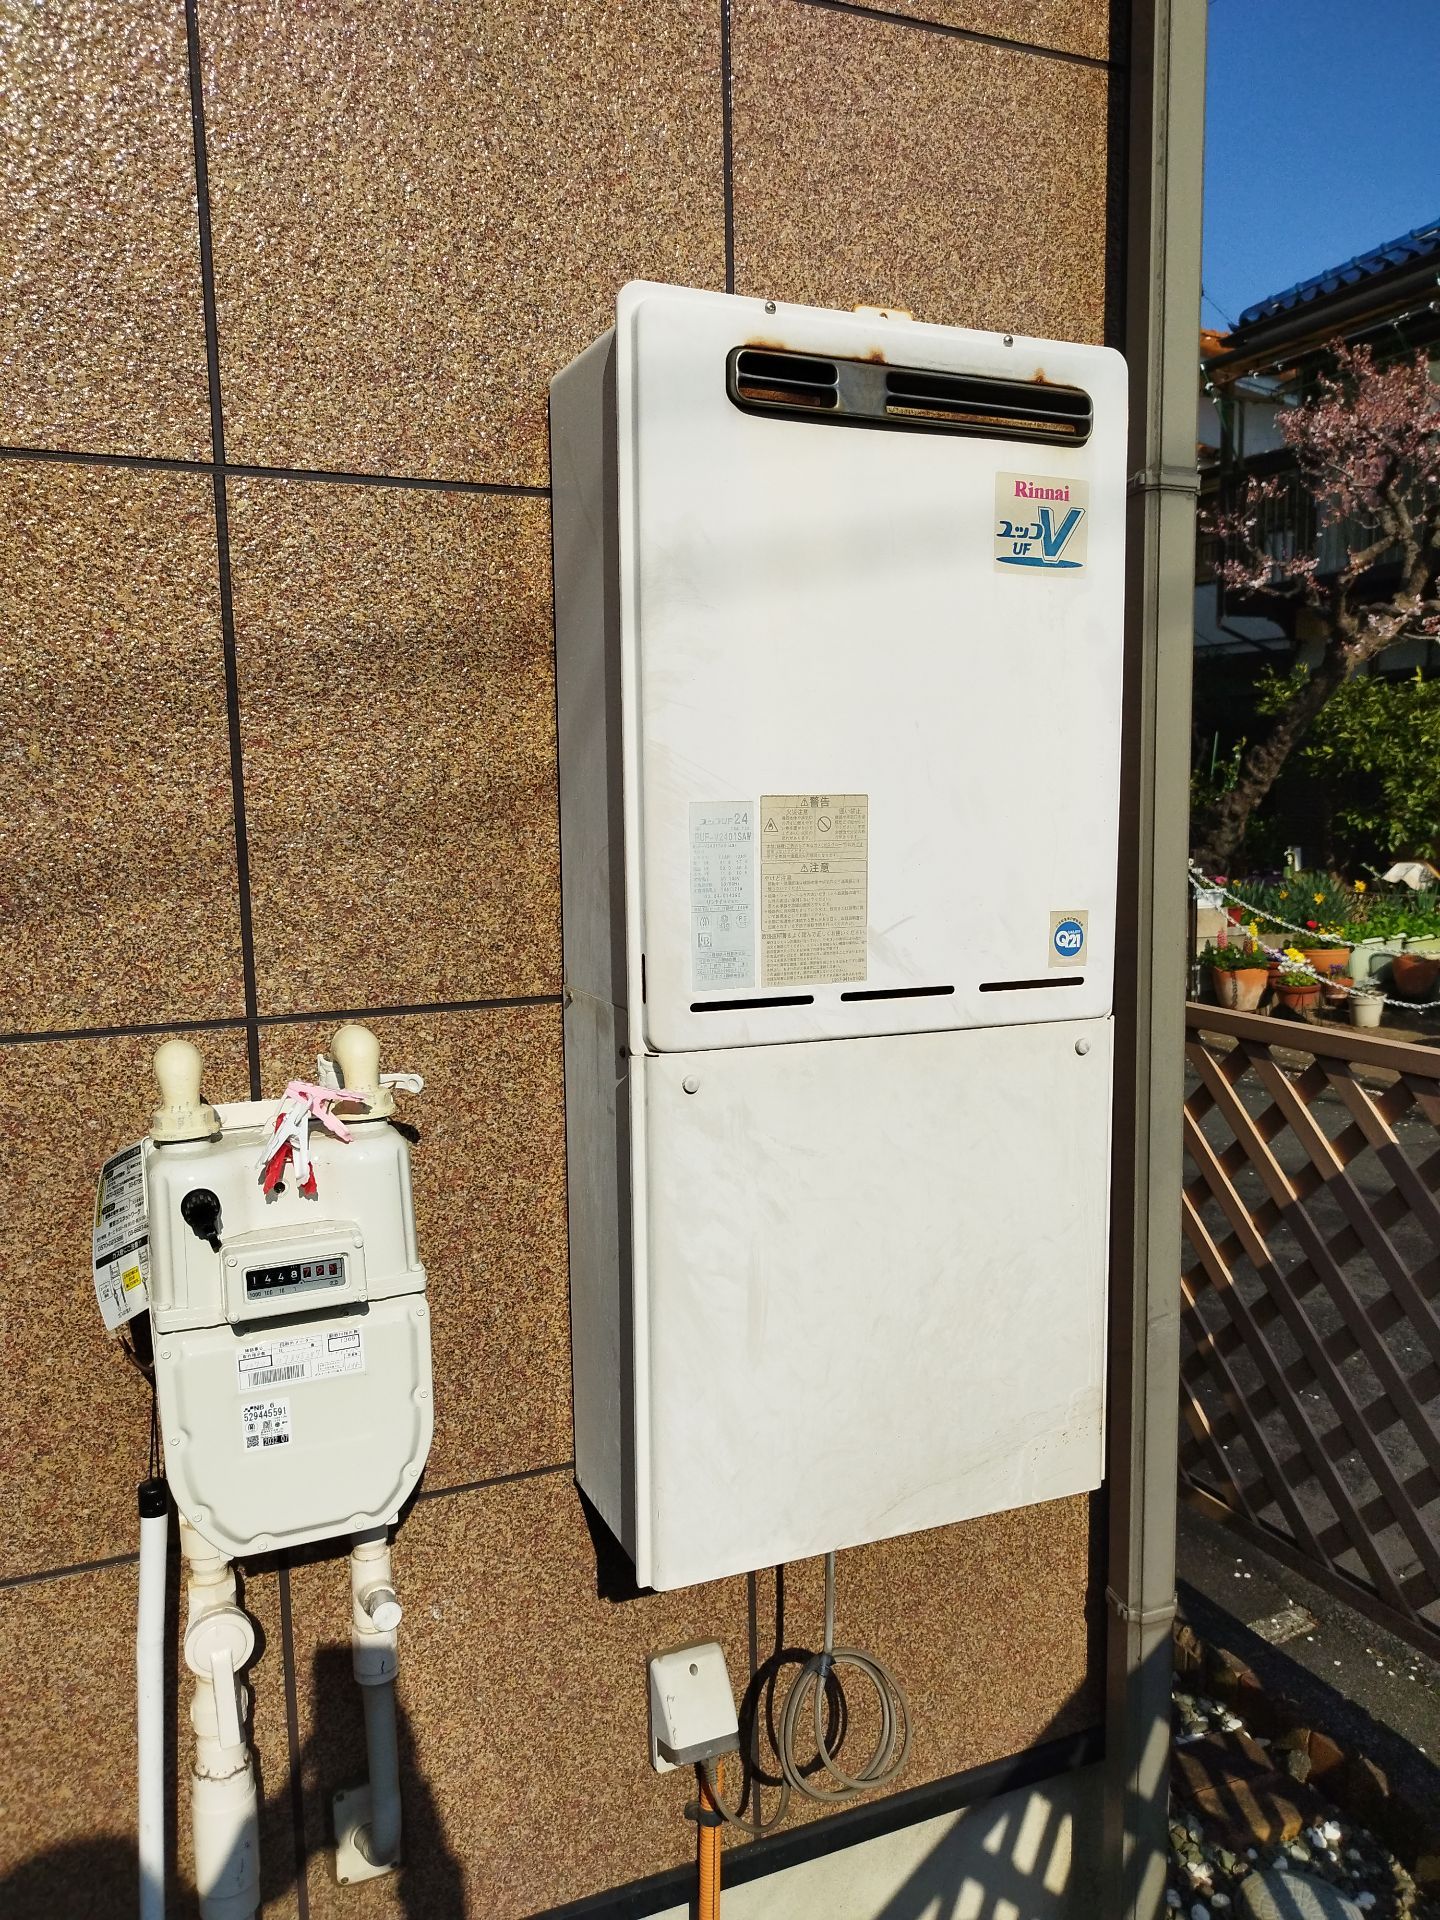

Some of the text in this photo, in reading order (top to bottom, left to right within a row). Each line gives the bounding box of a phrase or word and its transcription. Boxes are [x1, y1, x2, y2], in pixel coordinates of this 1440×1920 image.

[1014, 480, 1069, 501] Rinnai
[1012, 542, 1032, 555] UF
[810, 796, 830, 808] 警告
[734, 812, 748, 825] 24
[810, 862, 830, 873] 注意
[1056, 931, 1081, 948] Q21
[244, 1406, 286, 1422] 529445591
